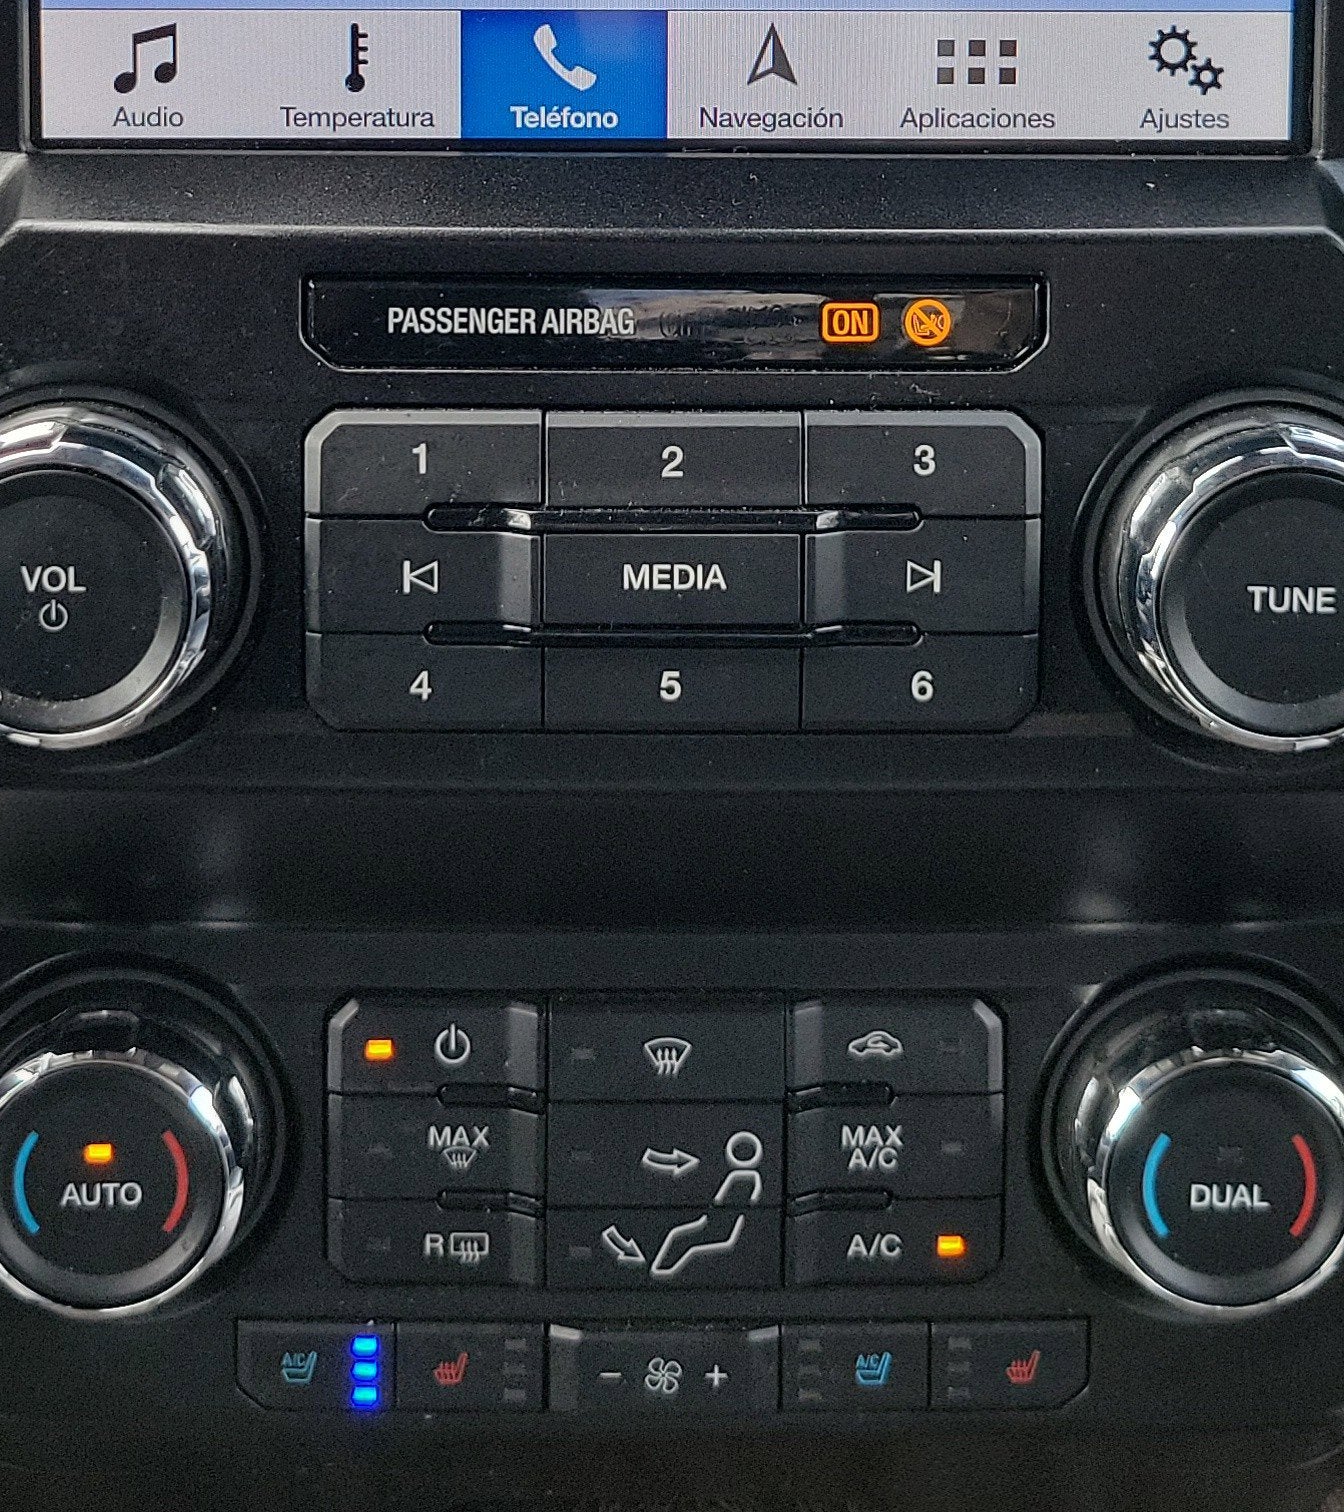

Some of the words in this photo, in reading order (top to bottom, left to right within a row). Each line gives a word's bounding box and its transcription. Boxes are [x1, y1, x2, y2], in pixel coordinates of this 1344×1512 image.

[112, 105, 185, 128] Audio
[279, 106, 436, 133] Temperatura
[511, 106, 619, 129] Teléfono
[699, 106, 844, 134] Navegación
[899, 106, 1056, 134] Aplicaciones
[1139, 107, 1230, 134] Ajustes
[388, 307, 537, 334] PASSENGER
[541, 308, 635, 335] AIRBAG
[832, 309, 870, 336] ON
[412, 443, 427, 475] 1
[661, 445, 684, 478] 2
[913, 444, 936, 476] 3
[20, 565, 87, 593] VOL
[623, 563, 727, 590] MEDIA
[1247, 585, 1336, 614] TUNE
[409, 670, 432, 701] 4
[659, 670, 682, 701] 5
[911, 670, 934, 702] 6
[428, 1125, 490, 1147] MAX
[841, 1125, 903, 1148] MAX
[848, 1146, 899, 1171] A/C
[60, 1182, 143, 1207] AUTO
[1190, 1183, 1270, 1209] DUAL
[424, 1233, 444, 1256] R
[847, 1233, 902, 1258] A/C
